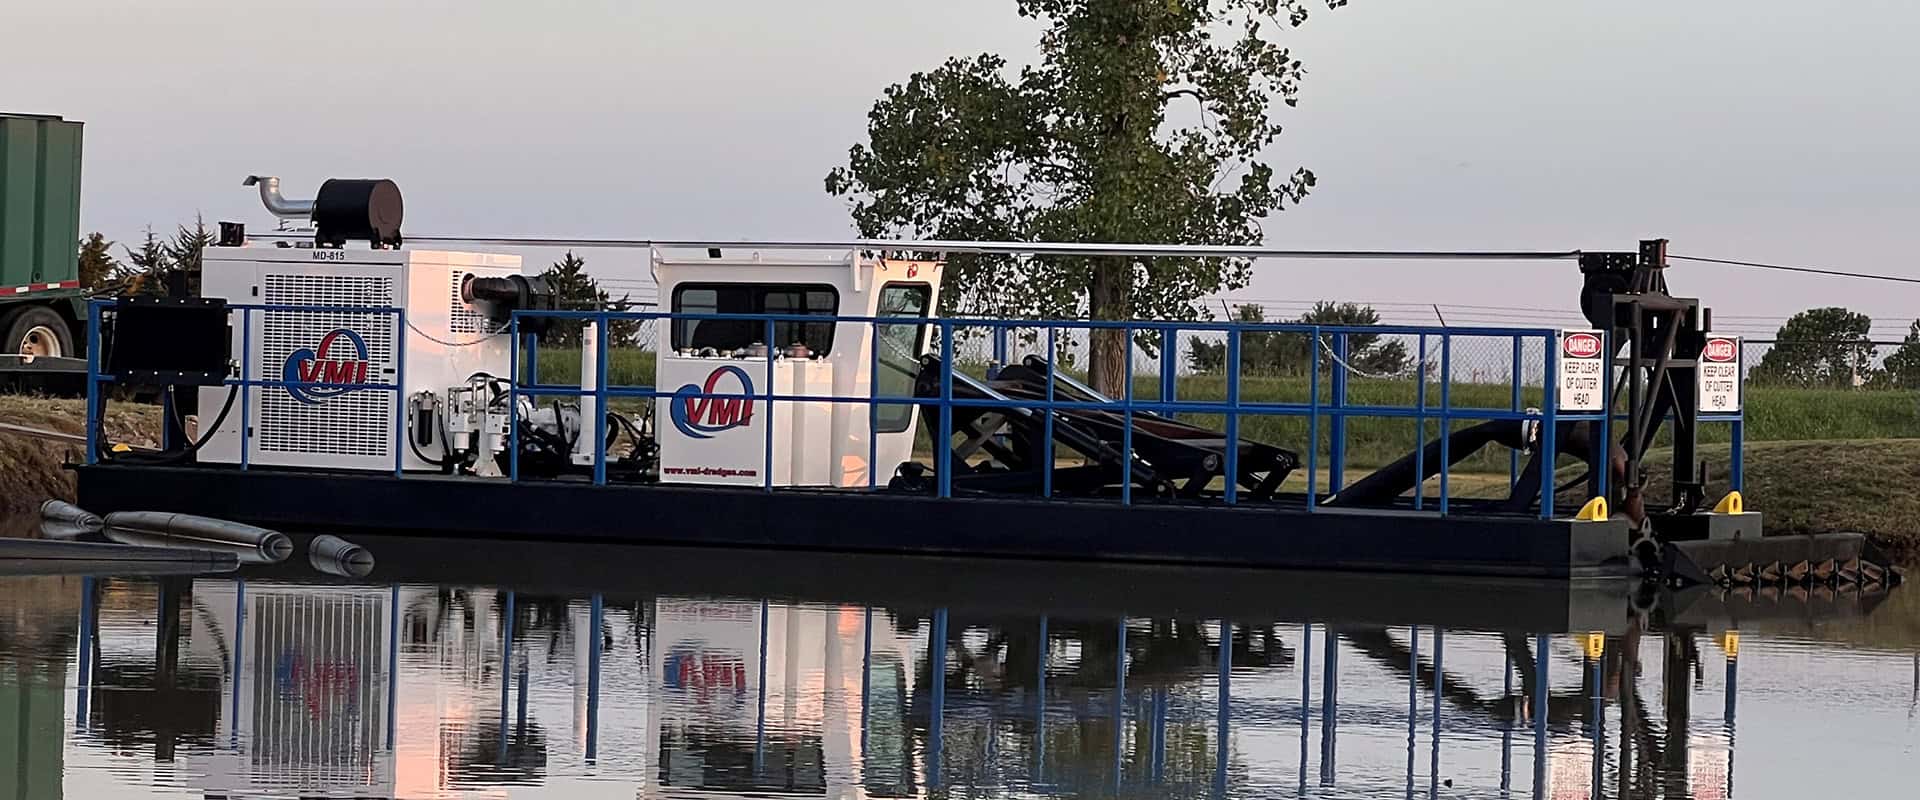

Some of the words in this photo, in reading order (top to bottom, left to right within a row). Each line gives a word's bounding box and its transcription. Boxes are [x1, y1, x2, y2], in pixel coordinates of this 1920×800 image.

[1567, 338, 1597, 353] DANGER
[1707, 342, 1733, 357] DANGER
[300, 360, 368, 385] VMI
[1565, 361, 1579, 374] KEEP
[1581, 361, 1600, 374] CLEAR
[1704, 366, 1717, 377] KEEP
[1719, 366, 1735, 377] CLEAR
[1566, 377, 1574, 389] OF
[1576, 377, 1597, 389] CUTTER
[1705, 380, 1712, 392] OF
[1713, 380, 1733, 392] CUTTER
[1574, 392, 1589, 405] HEAD
[1712, 395, 1726, 407] HEAD
[685, 395, 754, 426] VMI
